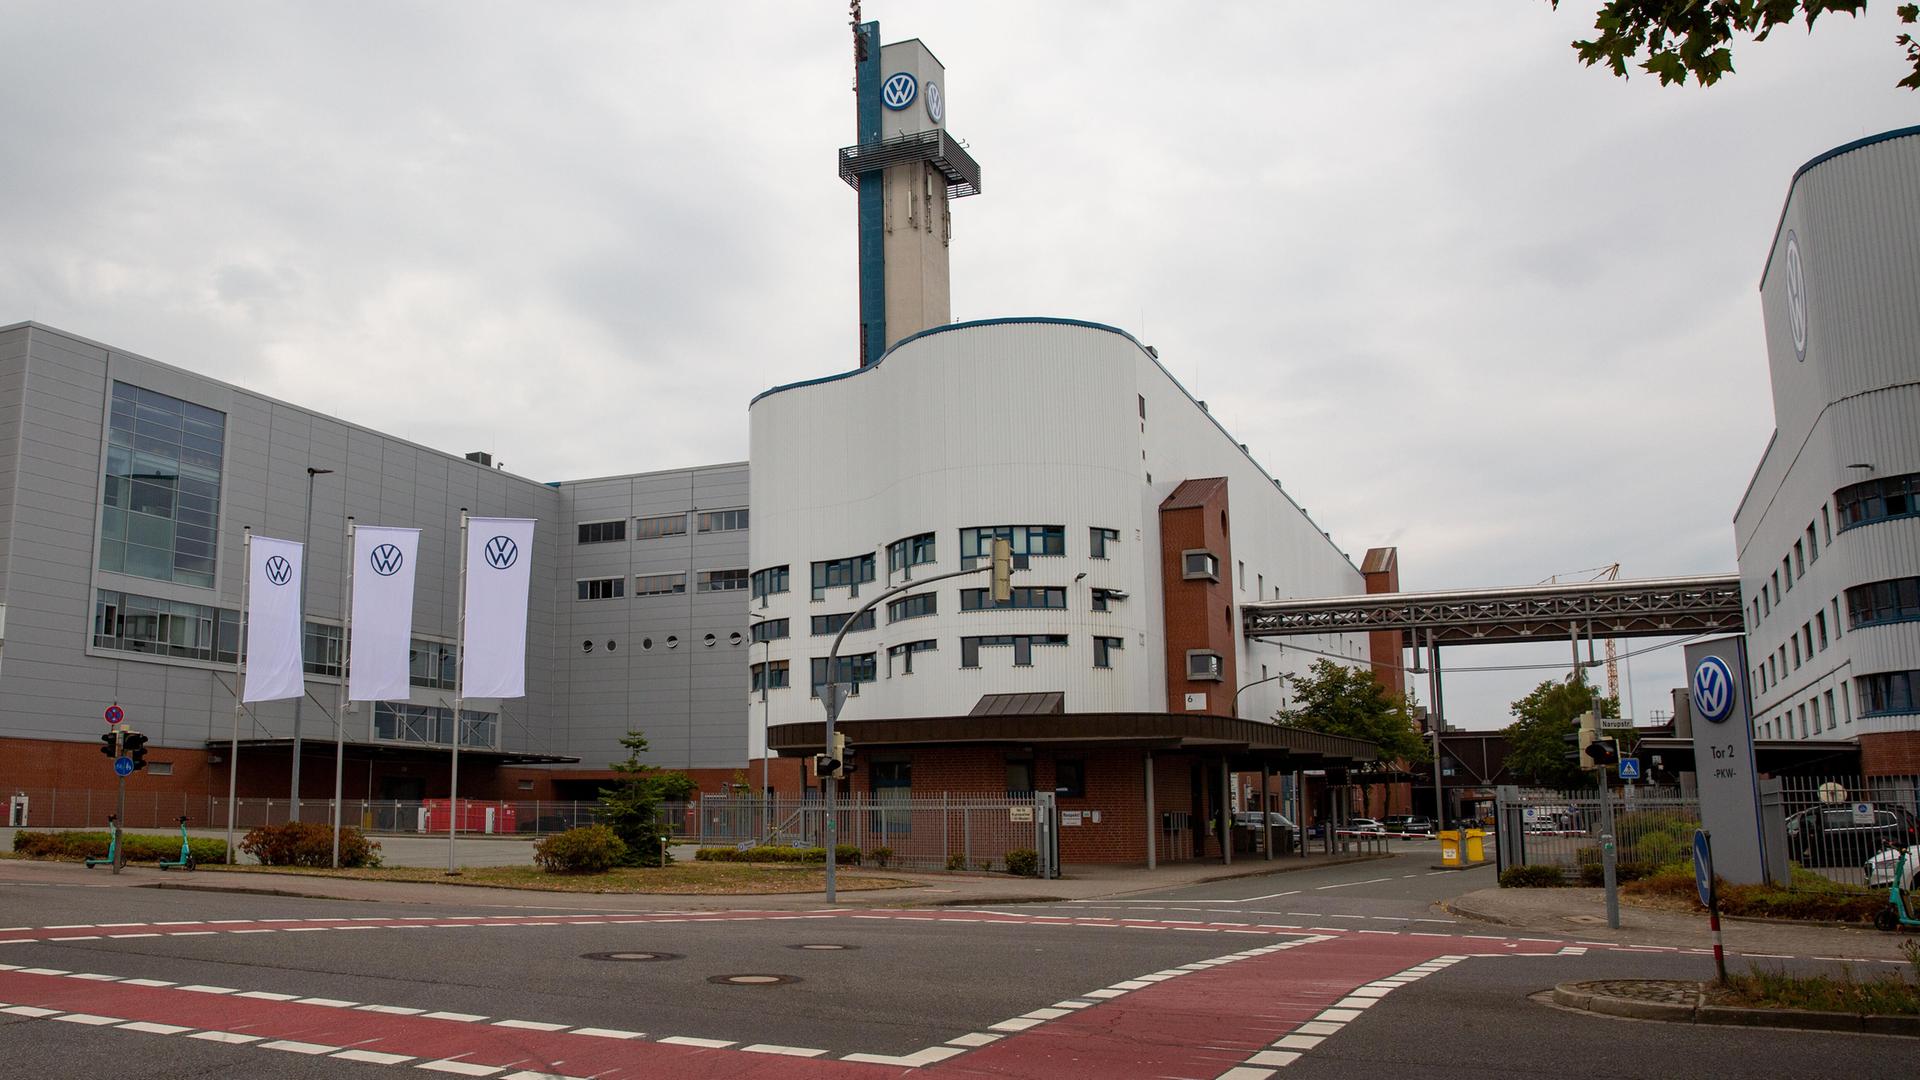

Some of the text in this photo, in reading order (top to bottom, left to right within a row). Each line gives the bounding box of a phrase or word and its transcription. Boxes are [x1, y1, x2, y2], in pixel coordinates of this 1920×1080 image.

[1187, 695, 1193, 703] 6
[1710, 744, 1735, 759] Tor 2
[1713, 768, 1737, 779] -PKW-
